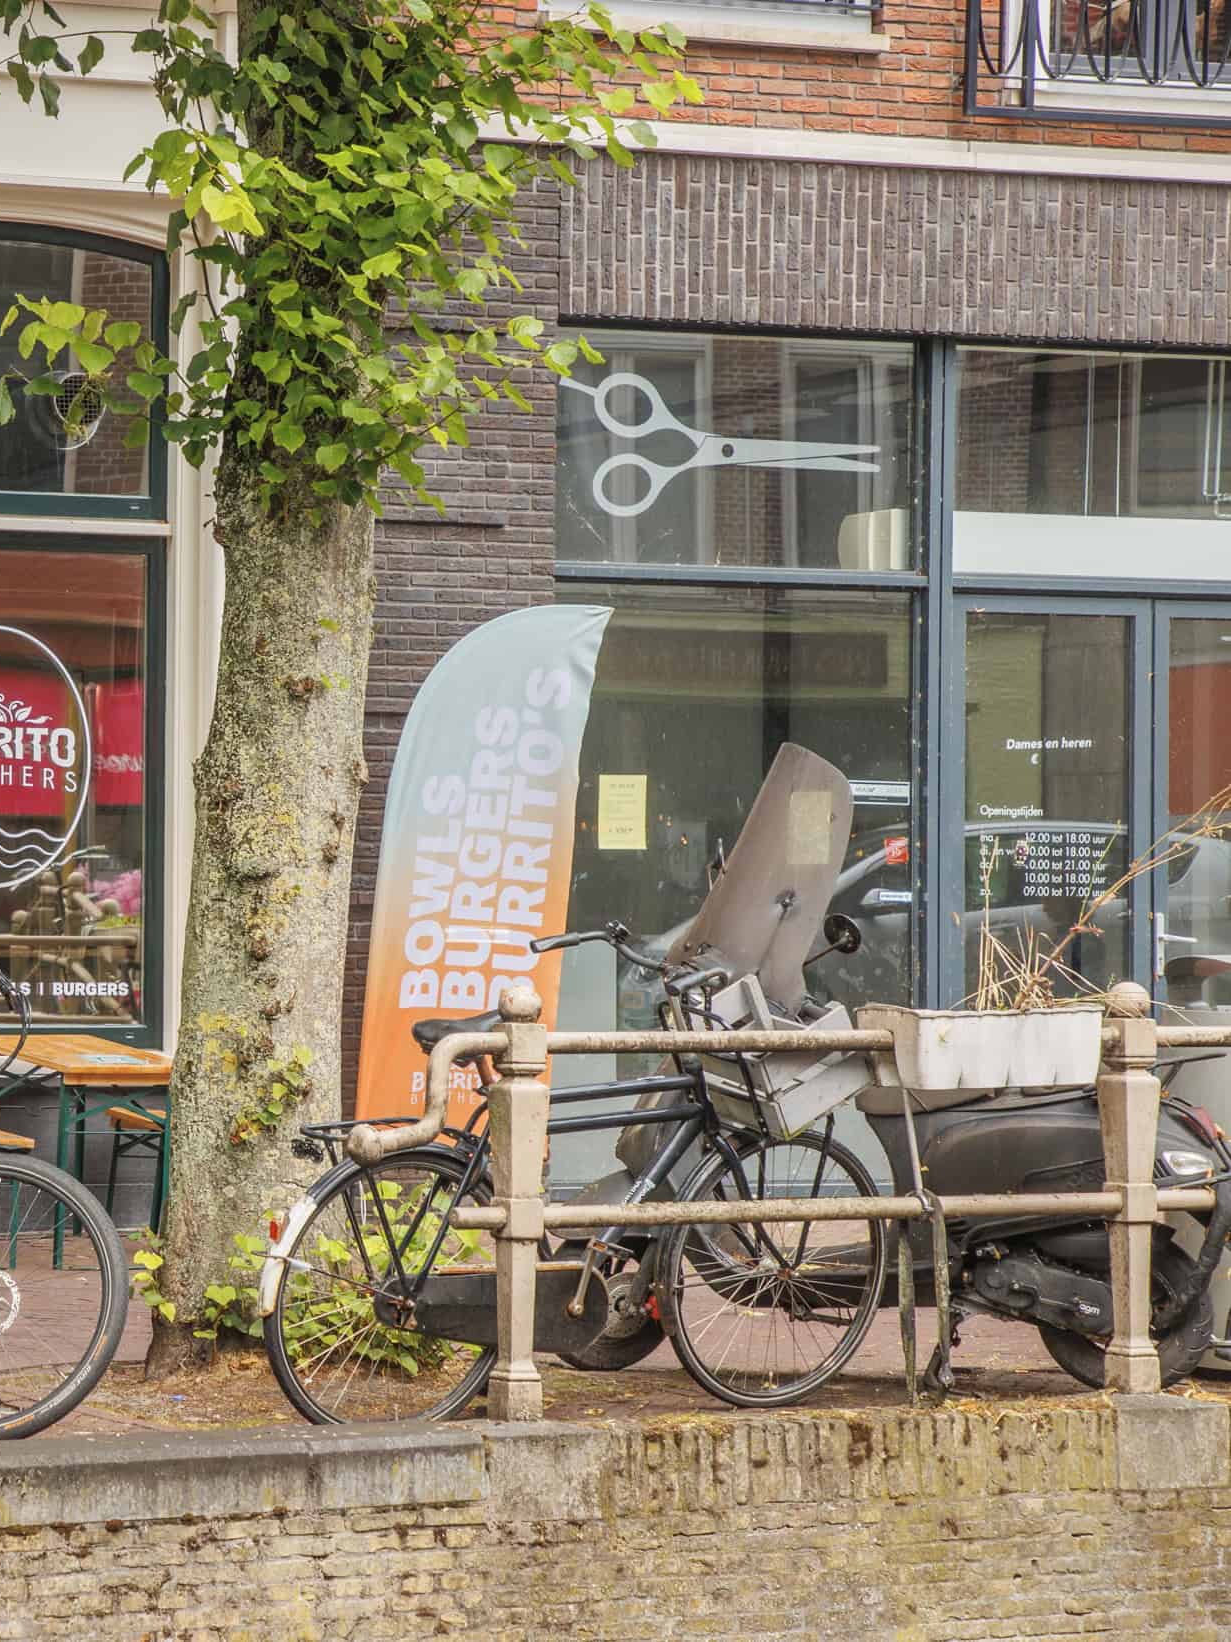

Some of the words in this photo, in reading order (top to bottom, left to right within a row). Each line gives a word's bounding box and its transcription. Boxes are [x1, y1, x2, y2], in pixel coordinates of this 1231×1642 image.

[1006, 739, 1042, 750] Dames
[1045, 740, 1059, 749] en
[1061, 737, 1092, 749] heren
[979, 804, 1044, 818] Openingstijden
[1024, 833, 1050, 843] 12.00
[1051, 834, 1063, 843] tot
[1065, 833, 1091, 843] 18.00
[440, 704, 519, 1010] BURGERS
[1029, 846, 1050, 857] 0.00
[1051, 847, 1063, 857] tot
[1065, 846, 1091, 857] 18.00
[1051, 860, 1063, 870] tot
[1064, 860, 1091, 870] 21.00
[1024, 873, 1050, 883] 10.00
[1051, 873, 1063, 883] tot
[1065, 873, 1091, 883] 18.00
[1092, 876, 1107, 884] uur
[398, 774, 466, 1009] BOWLS
[1023, 886, 1050, 897] 09.00
[1051, 887, 1063, 897] tot
[1065, 886, 1091, 897] 17.00
[52, 982, 130, 996] BURGERS
